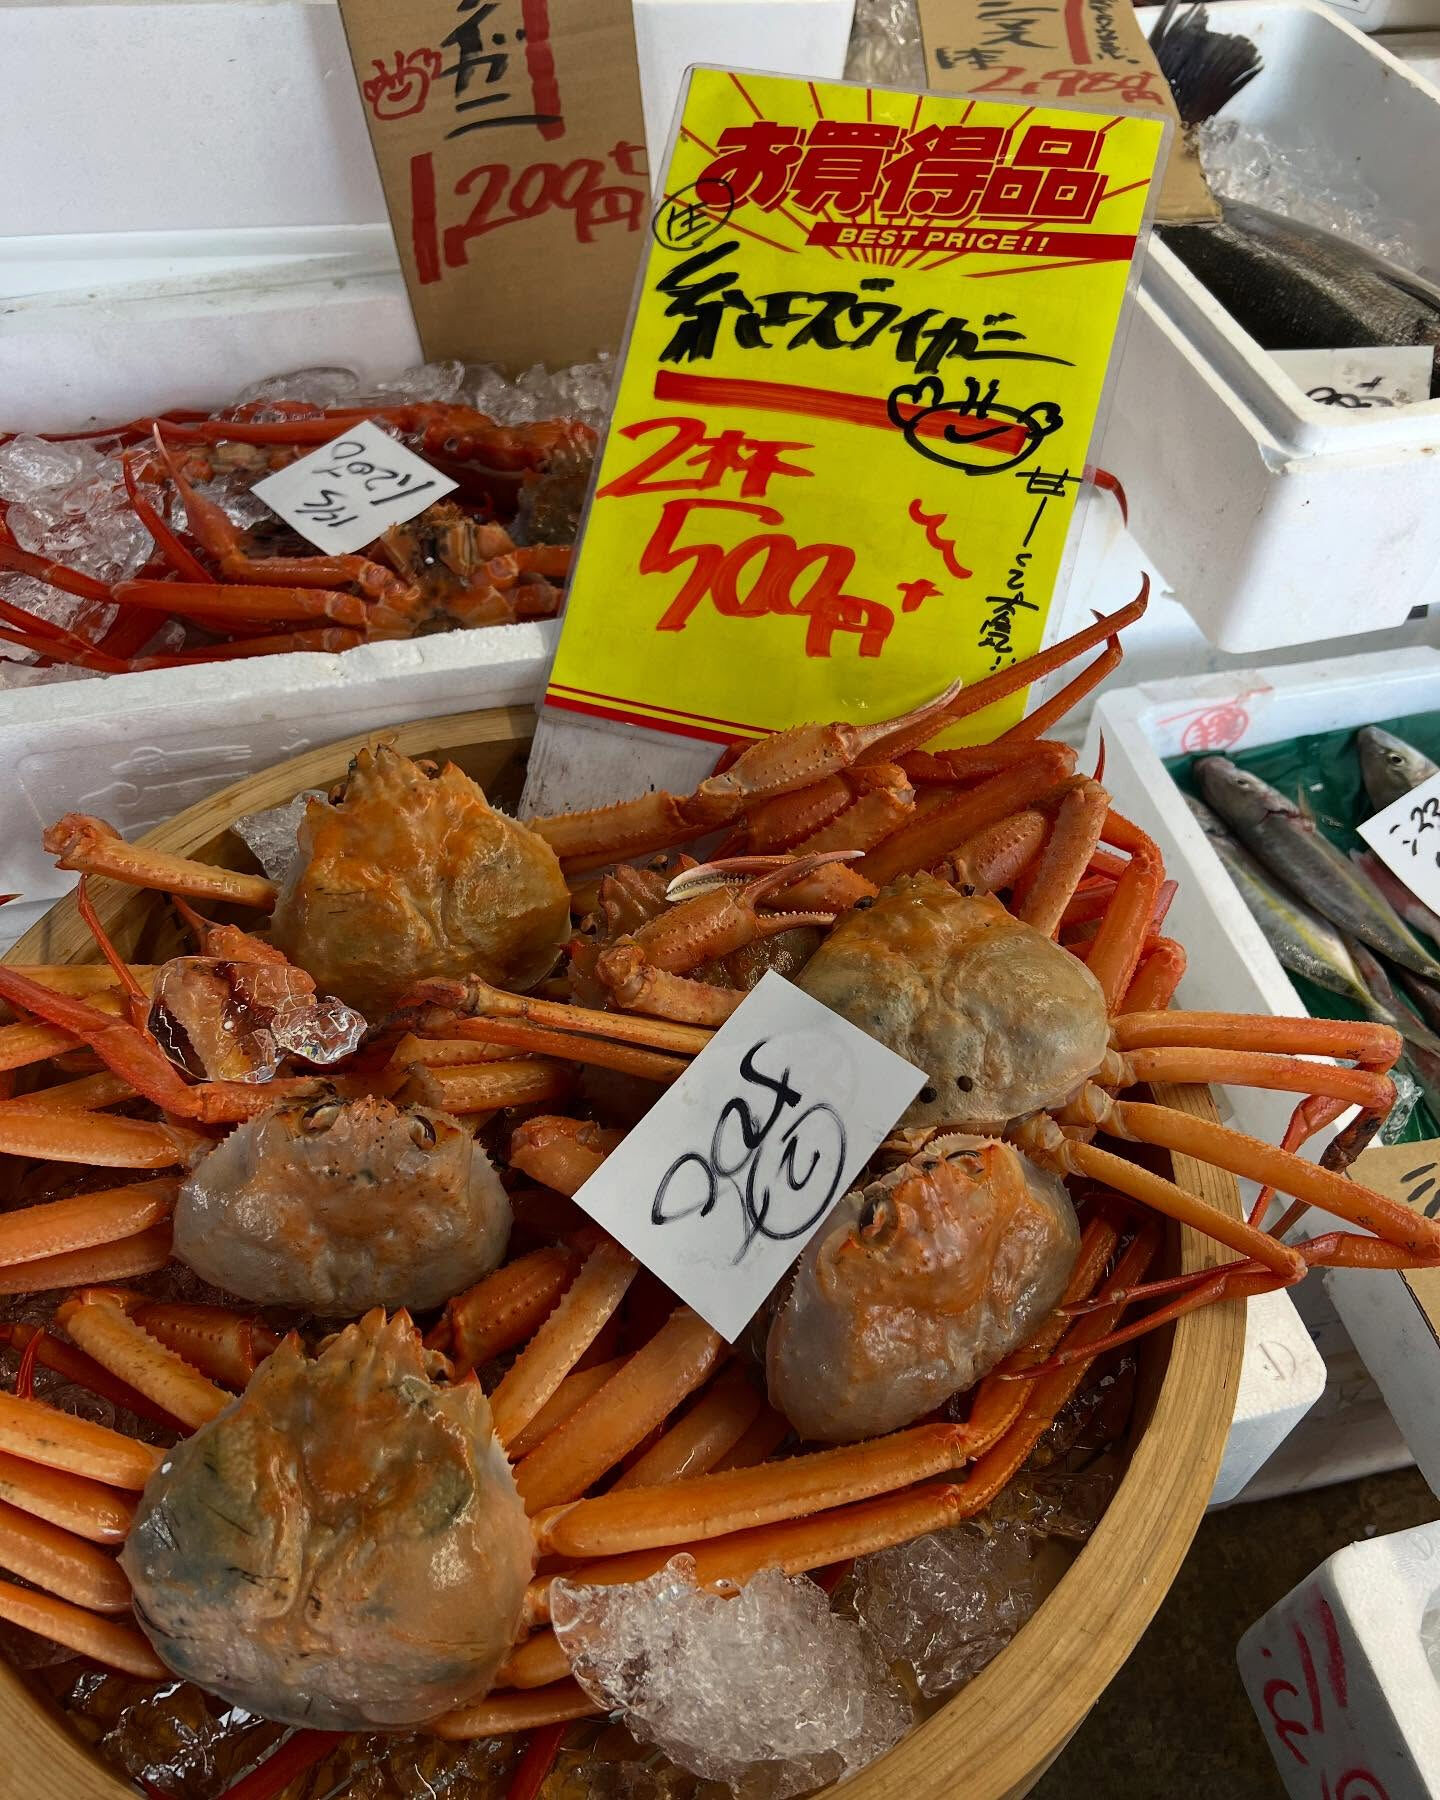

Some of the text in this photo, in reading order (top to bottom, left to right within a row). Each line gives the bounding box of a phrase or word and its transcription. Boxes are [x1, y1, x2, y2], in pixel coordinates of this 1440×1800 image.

[696, 120, 1110, 224] お買得品
[836, 226, 1051, 254] BEST PRICE!!
[596, 416, 815, 498] 2杯
[640, 498, 894, 658] 500円
